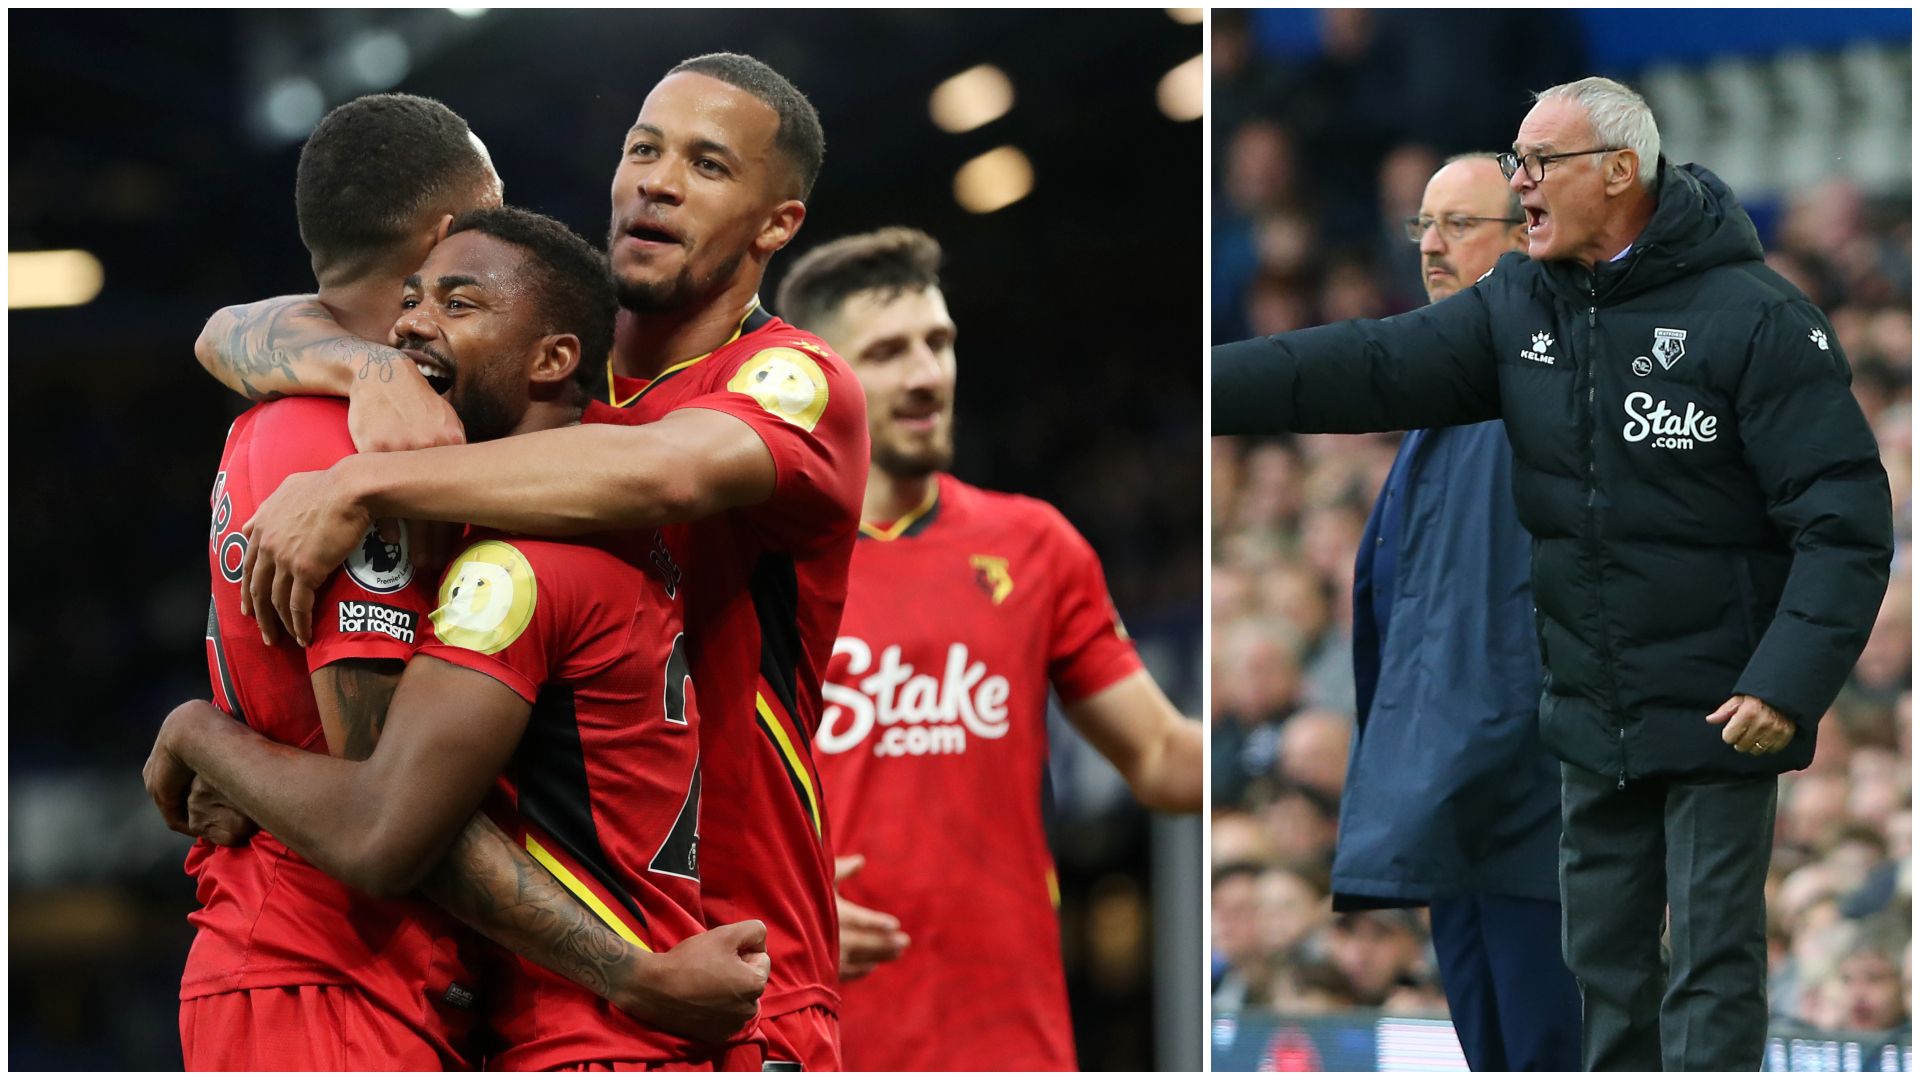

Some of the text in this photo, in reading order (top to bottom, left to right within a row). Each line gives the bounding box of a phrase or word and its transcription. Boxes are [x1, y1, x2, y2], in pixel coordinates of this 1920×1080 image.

[1521, 350, 1555, 364] KELME
[1623, 391, 1717, 442] Stake
[1651, 437, 1694, 450] .com
[376, 575, 401, 584] Premier
[339, 602, 410, 627] No room
[367, 619, 414, 643] racism
[815, 636, 1010, 754] Stake
[873, 725, 967, 757] .com
